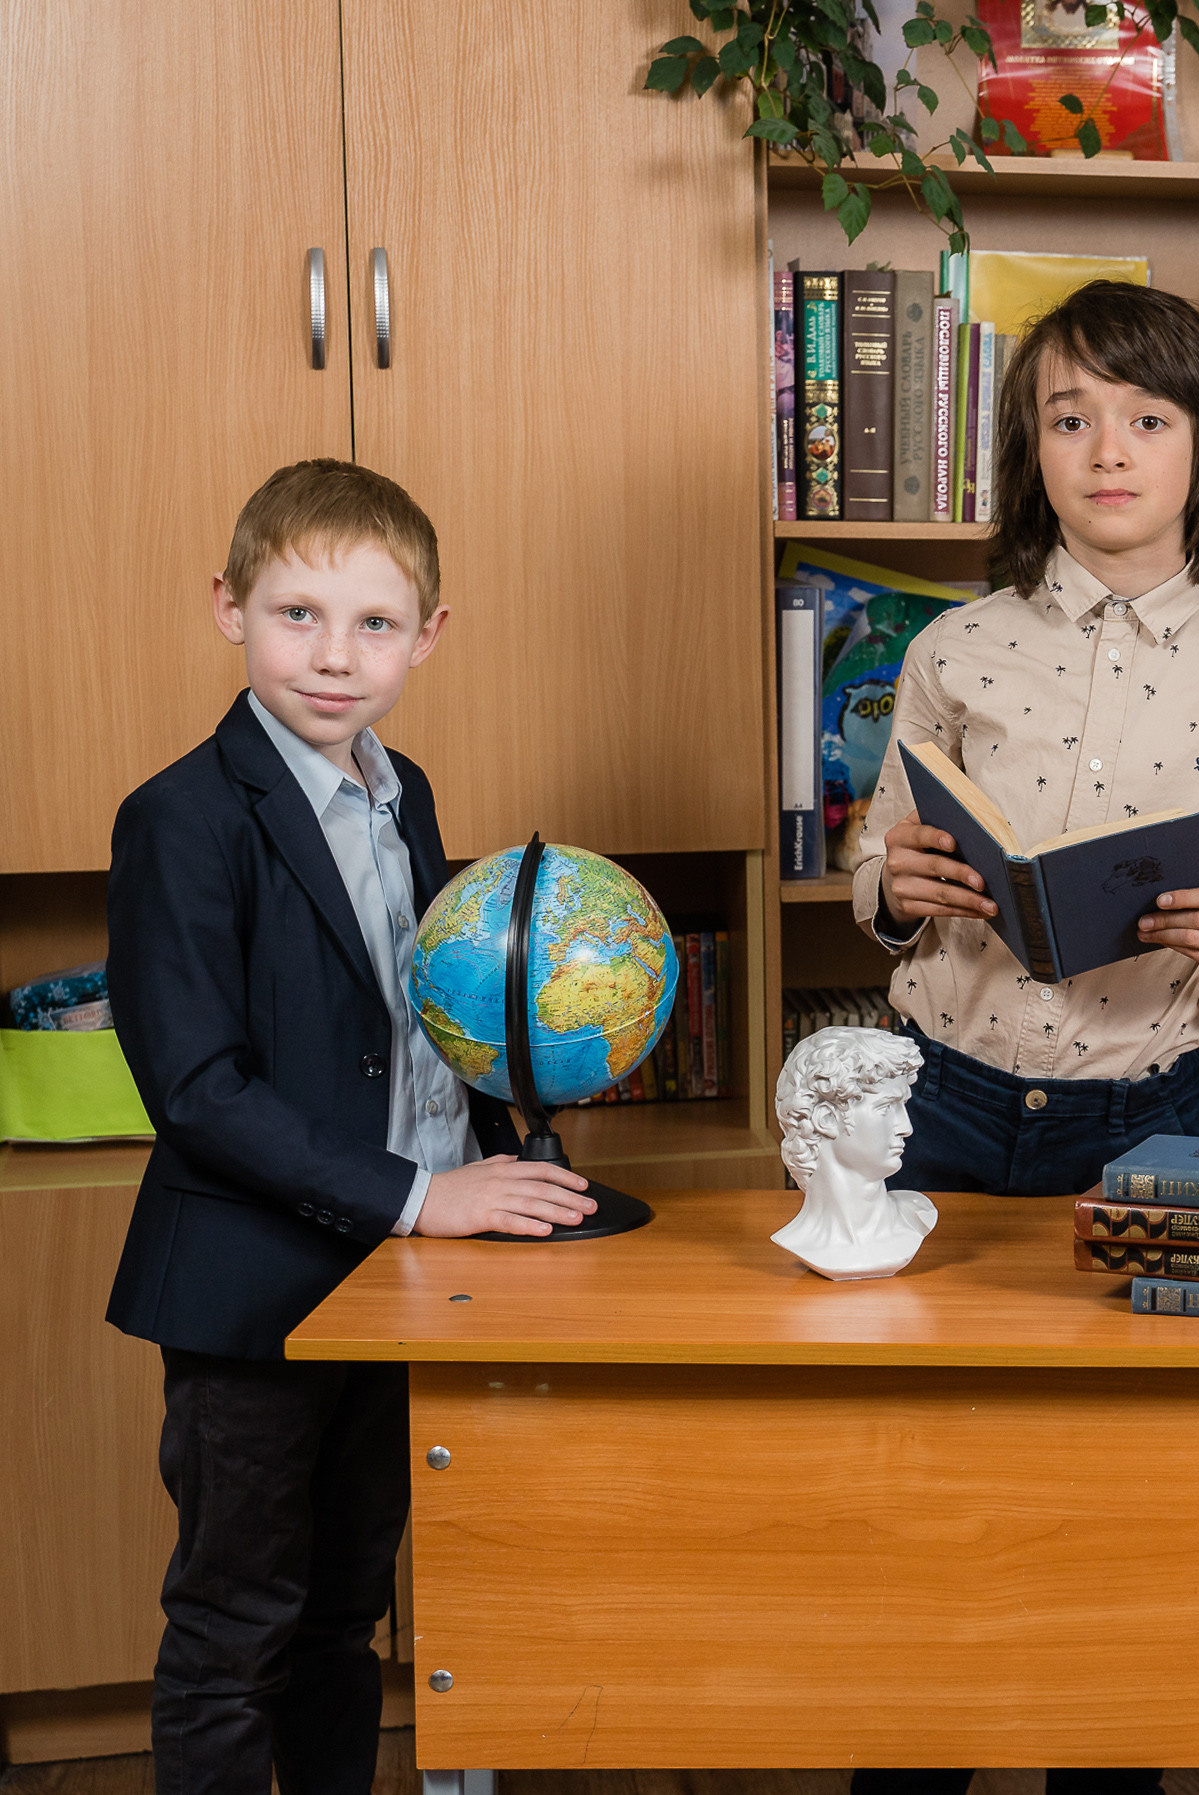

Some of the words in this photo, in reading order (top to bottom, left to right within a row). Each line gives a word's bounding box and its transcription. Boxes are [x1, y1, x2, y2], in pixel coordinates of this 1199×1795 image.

[901, 331, 912, 393] СЛОВАРЬ
[914, 337, 925, 383] ЯЗЫКА
[938, 310, 950, 391] ПОСЛОВИЦЫ
[913, 388, 925, 461] РУССКОГО
[937, 393, 949, 457] РУССКОГО
[937, 459, 949, 510] НАРОДА
[794, 815, 804, 871] ErichKrause
[1170, 1253, 1199, 1265] КУПЕР
